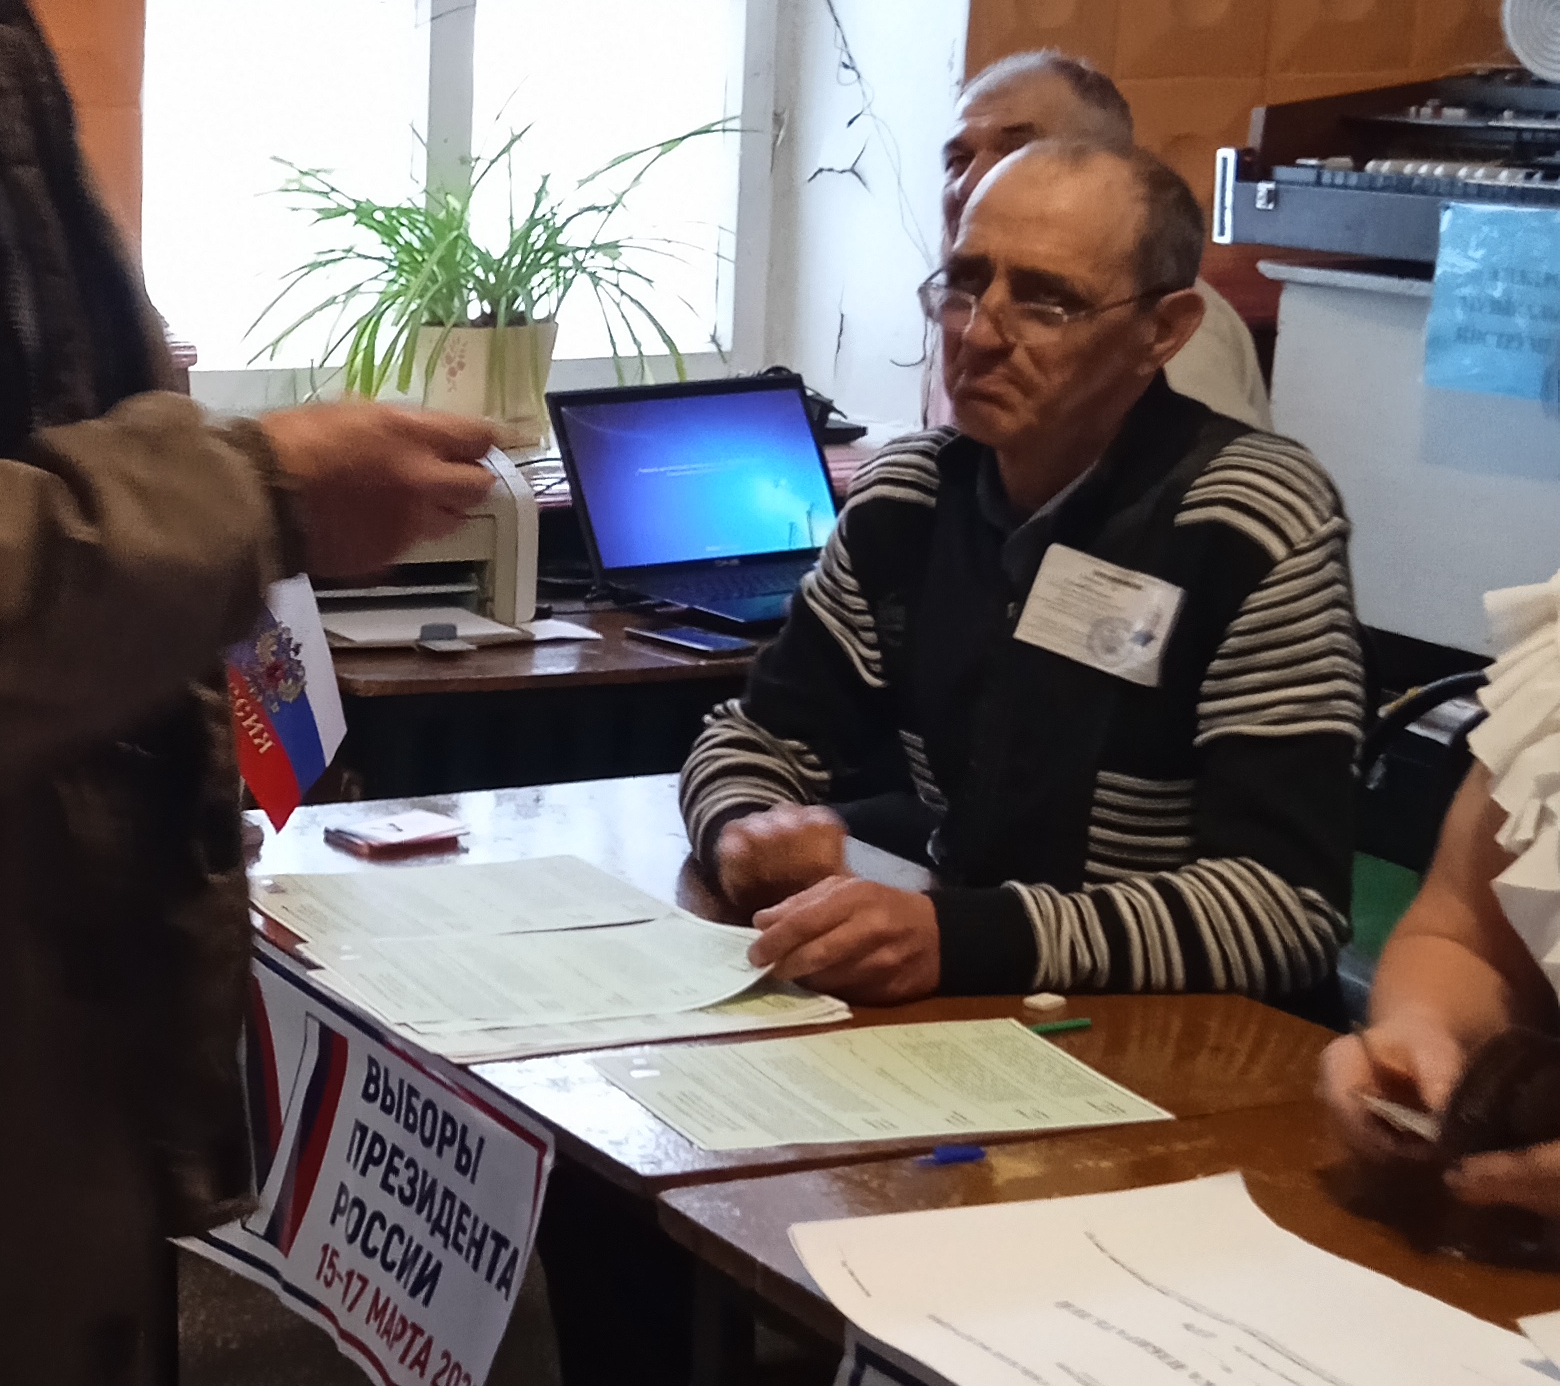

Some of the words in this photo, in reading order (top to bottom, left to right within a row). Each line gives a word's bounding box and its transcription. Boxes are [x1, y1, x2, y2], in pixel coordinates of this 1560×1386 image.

[361, 1054, 485, 1185] ВЫБОРЫ
[329, 1181, 443, 1308] РОССИИ
[346, 1118, 519, 1301] ПРЕЗИДЕНТА
[316, 1243, 369, 1313] 15-17
[366, 1287, 434, 1379] МАРТА
